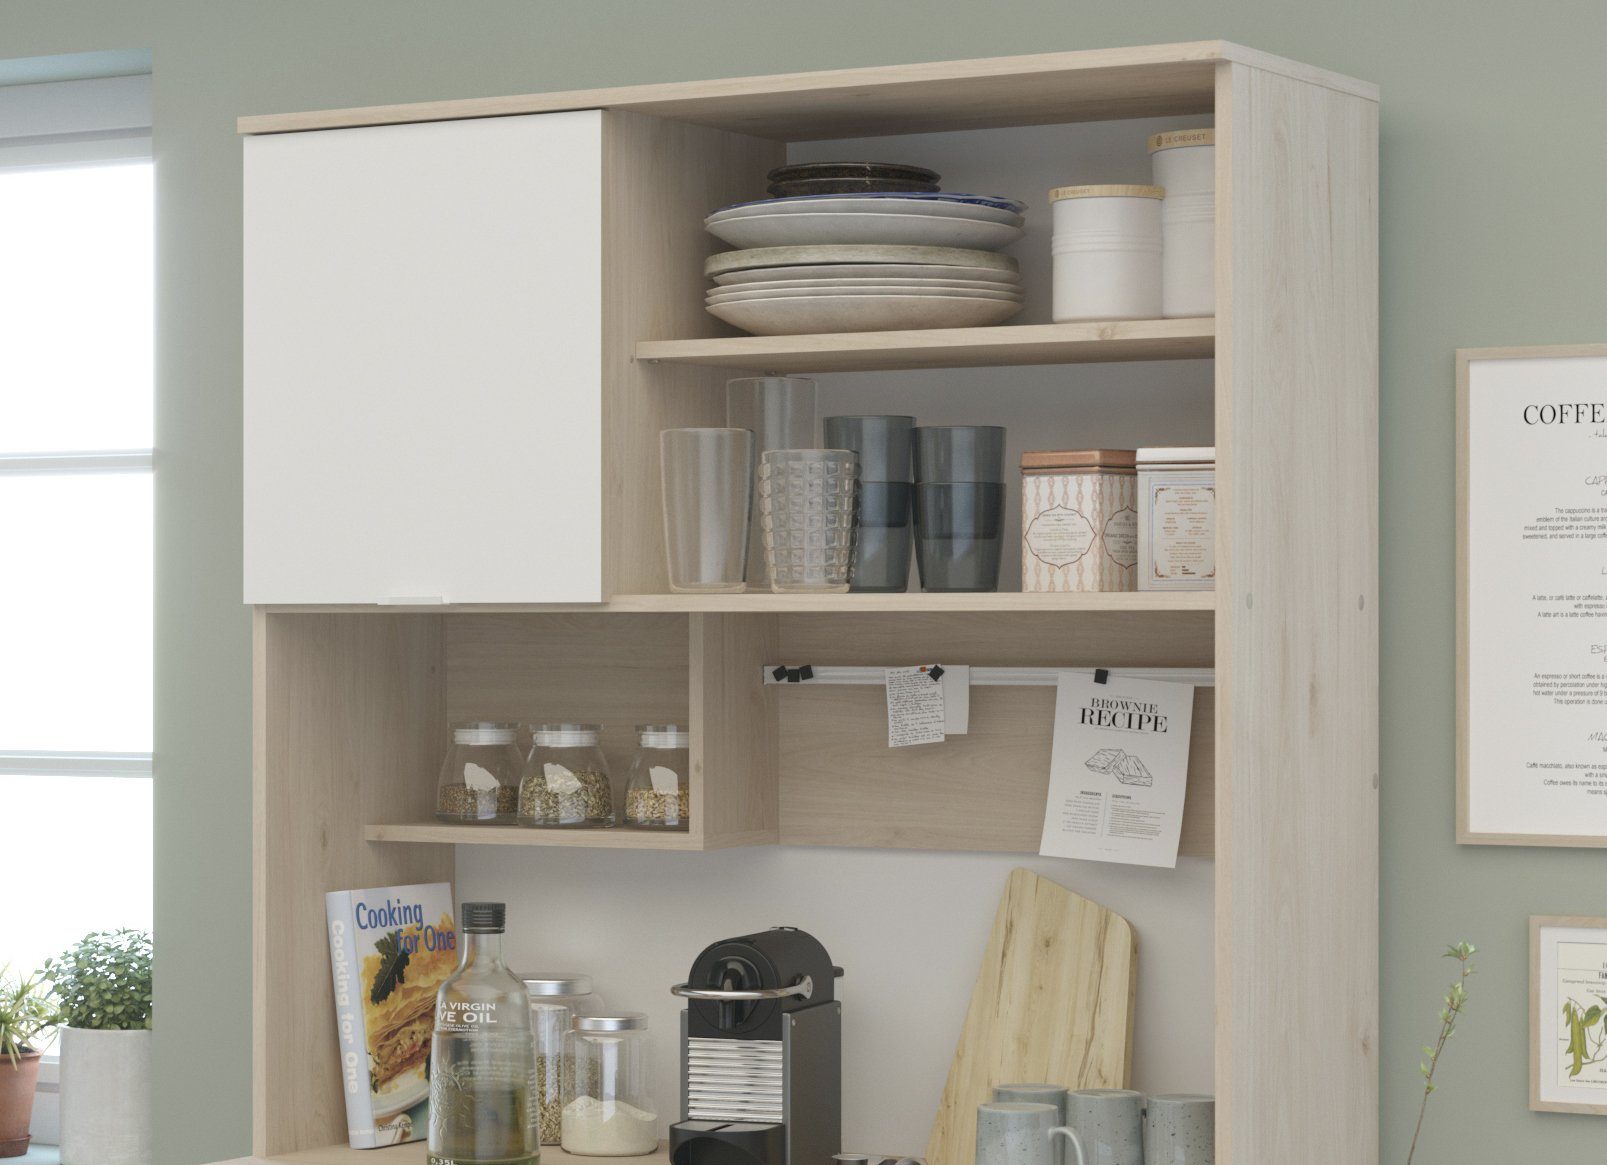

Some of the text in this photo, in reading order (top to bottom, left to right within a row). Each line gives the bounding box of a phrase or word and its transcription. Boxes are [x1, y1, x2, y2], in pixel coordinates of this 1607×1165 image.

[1090, 697, 1158, 714] BROWNIE
[1079, 707, 1168, 733] RECIPE
[355, 898, 424, 932] Cooking
[395, 924, 457, 955] for One
[331, 919, 359, 1094] Cooking for One
[449, 1001, 497, 1011] VIRGIN
[462, 1012, 498, 1023] OIL
